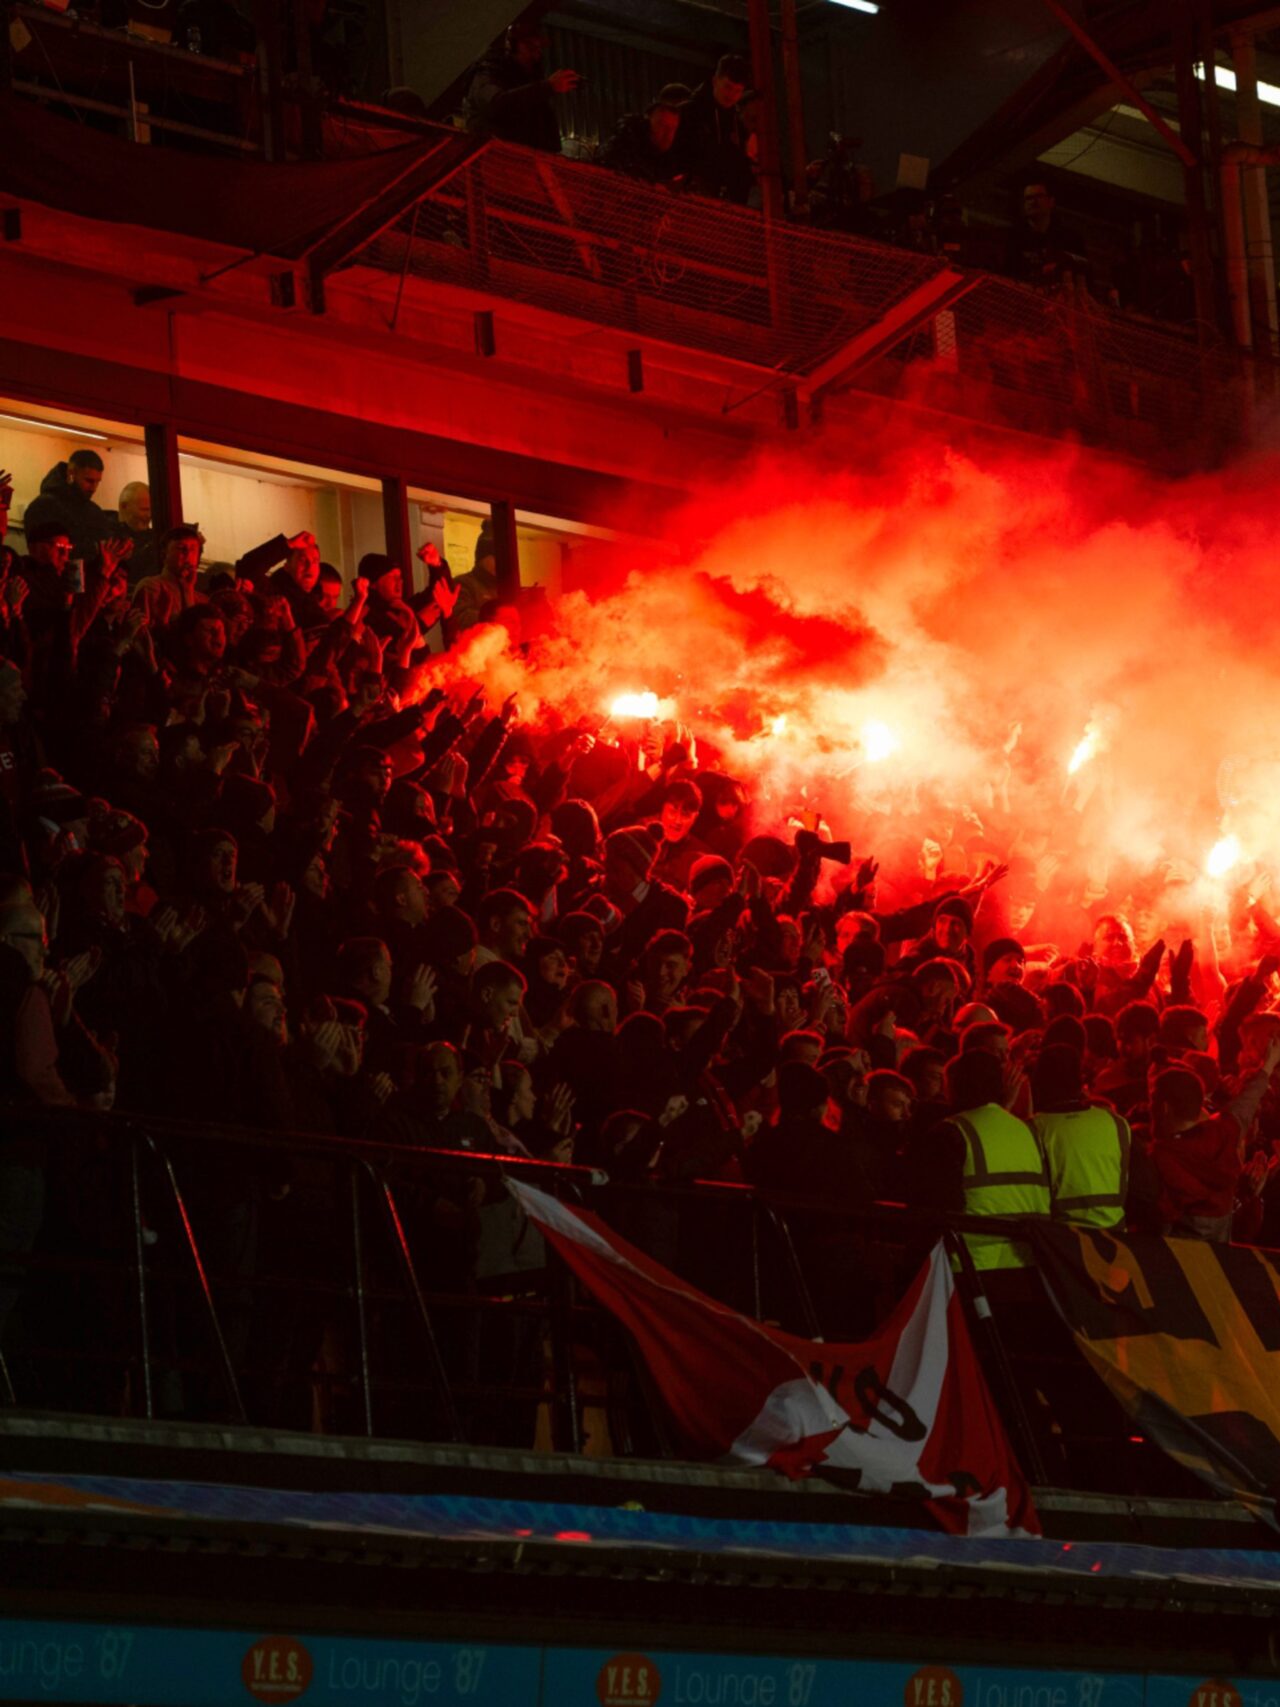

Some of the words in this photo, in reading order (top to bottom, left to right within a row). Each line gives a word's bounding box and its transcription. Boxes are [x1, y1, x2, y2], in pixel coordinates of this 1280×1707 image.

[252, 1648, 303, 1682] Y.E.S.
[328, 1648, 442, 1706] Lounge
[606, 1666, 652, 1697] Y.E.S.
